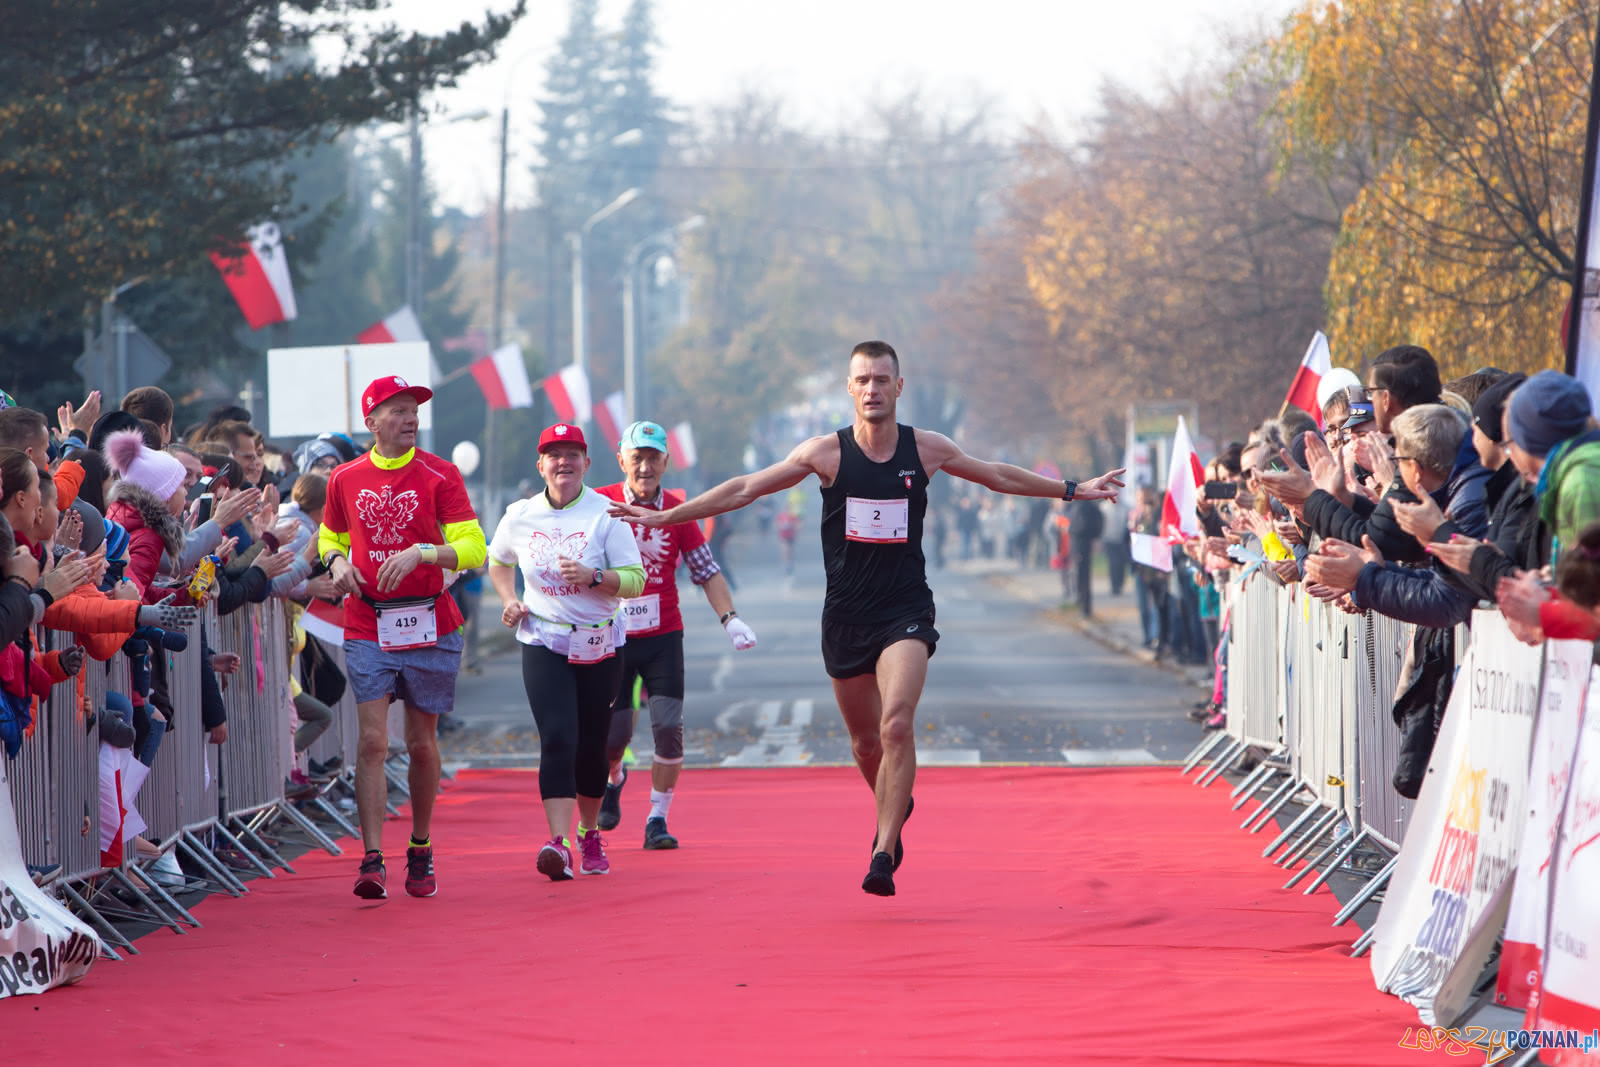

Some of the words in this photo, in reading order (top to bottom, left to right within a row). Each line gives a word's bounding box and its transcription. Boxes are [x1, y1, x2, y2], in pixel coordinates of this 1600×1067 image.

[873, 510, 881, 521] 2
[541, 584, 581, 597] POLSKA
[624, 604, 648, 616] 1206
[395, 616, 418, 629] 419
